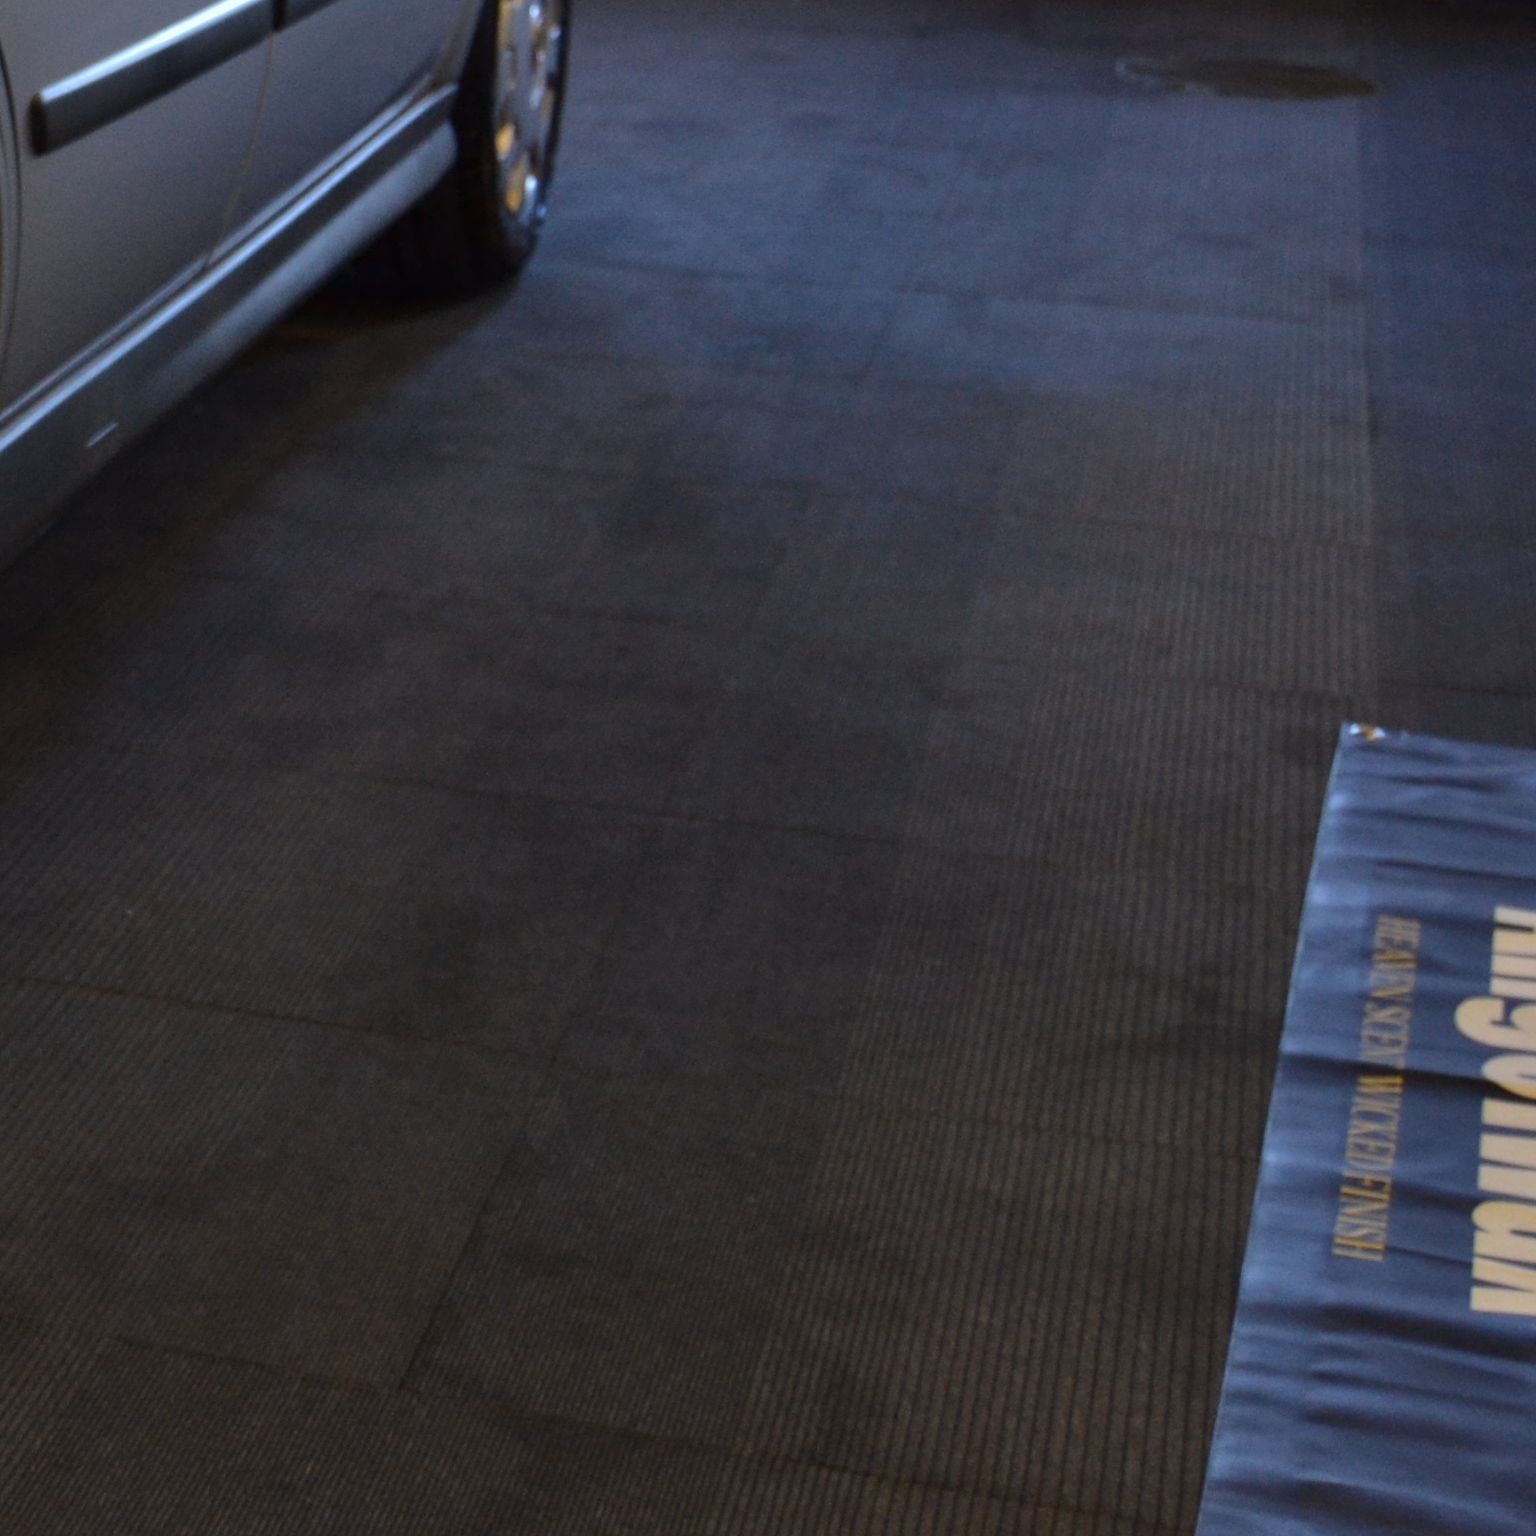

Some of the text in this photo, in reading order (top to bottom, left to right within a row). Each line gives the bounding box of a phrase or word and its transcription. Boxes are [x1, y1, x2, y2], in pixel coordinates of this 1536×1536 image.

[1360, 1001, 1411, 1070] SCEN
[1346, 1075, 1405, 1170] WICKED
[1331, 1169, 1393, 1262] FINISH
